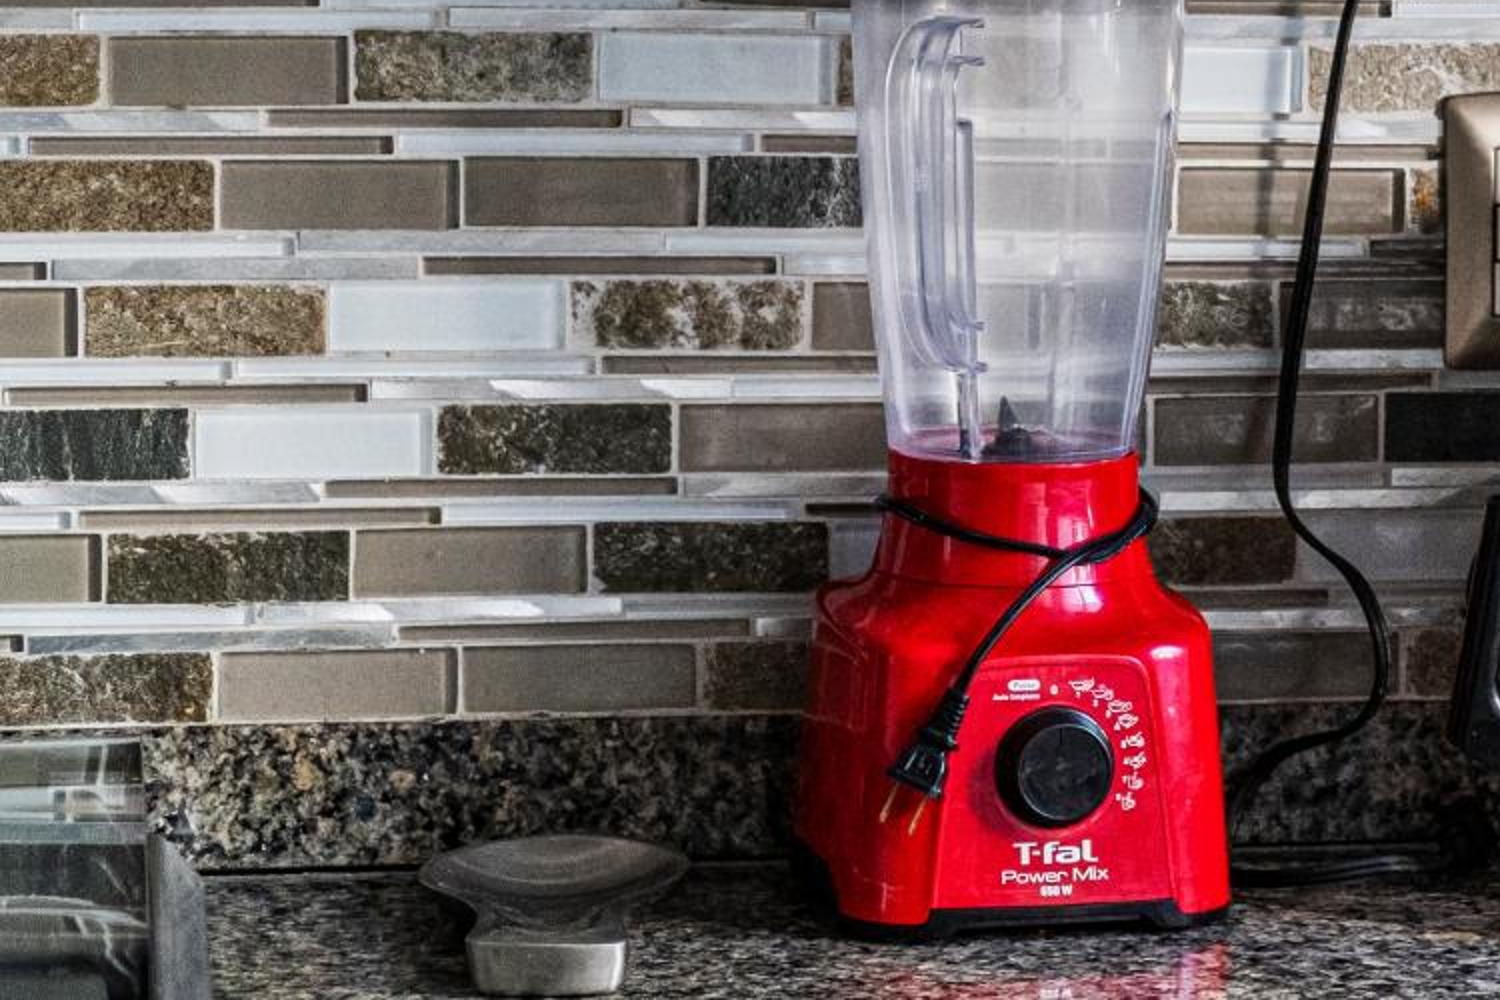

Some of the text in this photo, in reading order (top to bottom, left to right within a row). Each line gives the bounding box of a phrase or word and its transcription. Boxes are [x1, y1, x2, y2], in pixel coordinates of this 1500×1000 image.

[1012, 839, 1099, 866] T-fal
[1001, 865, 1110, 885] Power Mix
